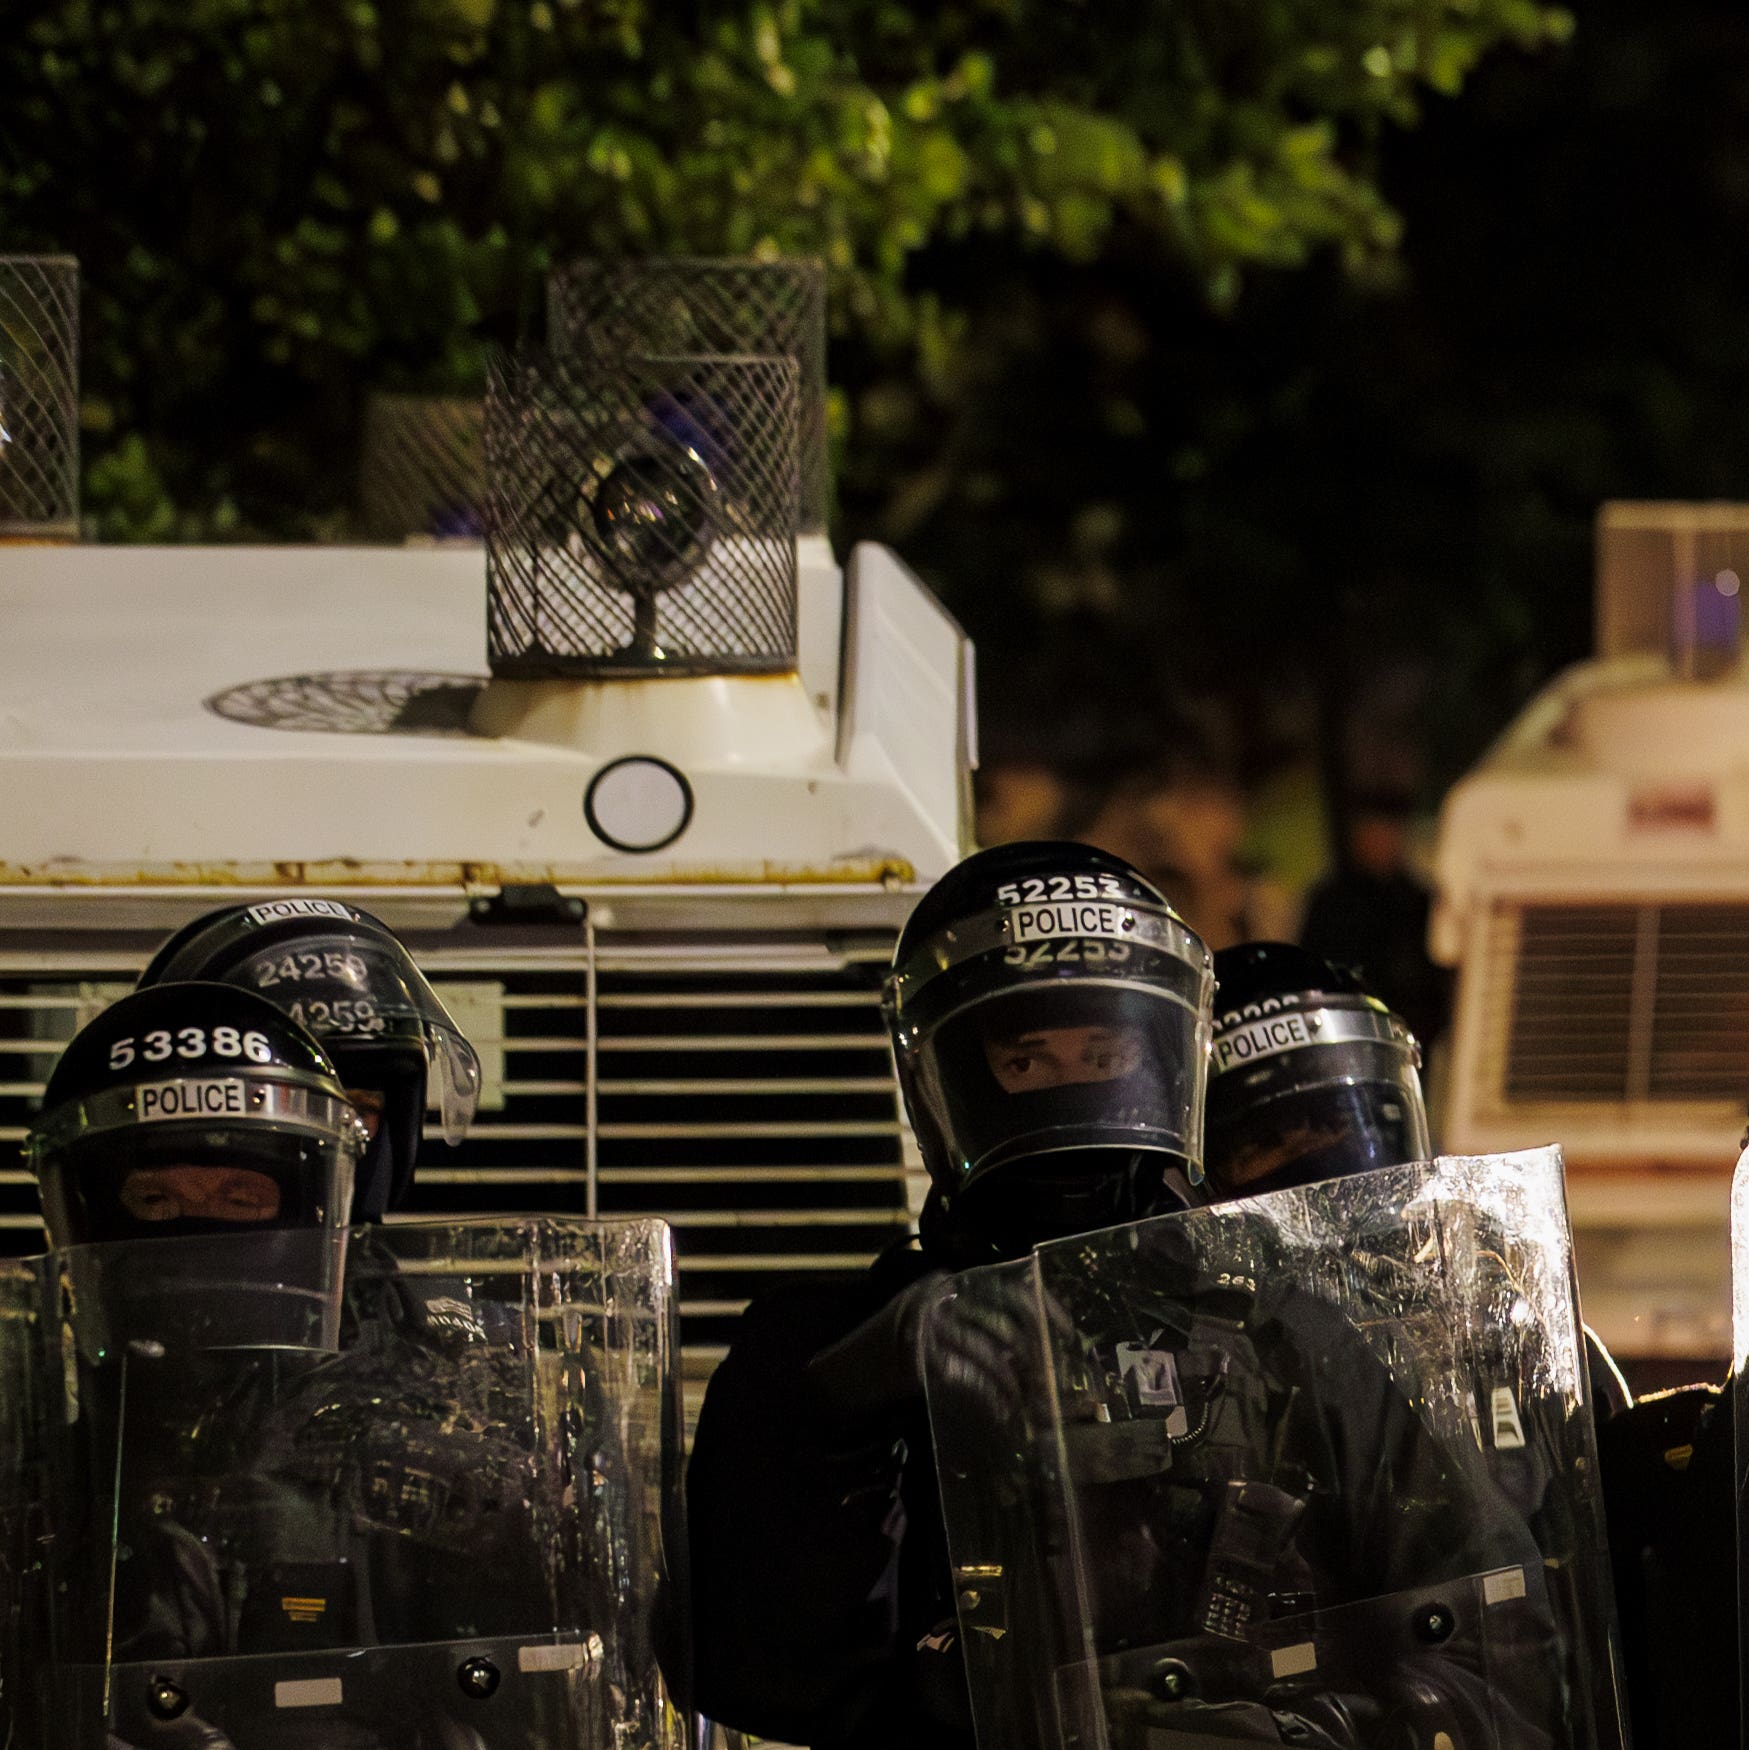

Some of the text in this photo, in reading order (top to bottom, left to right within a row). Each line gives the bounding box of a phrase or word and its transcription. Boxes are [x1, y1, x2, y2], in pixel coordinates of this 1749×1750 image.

[257, 901, 347, 921] POLICE
[1018, 907, 1115, 938] POLICE
[108, 1026, 272, 1070] 53386
[1218, 1018, 1305, 1067] POLICE
[142, 1085, 241, 1115] POLICE
